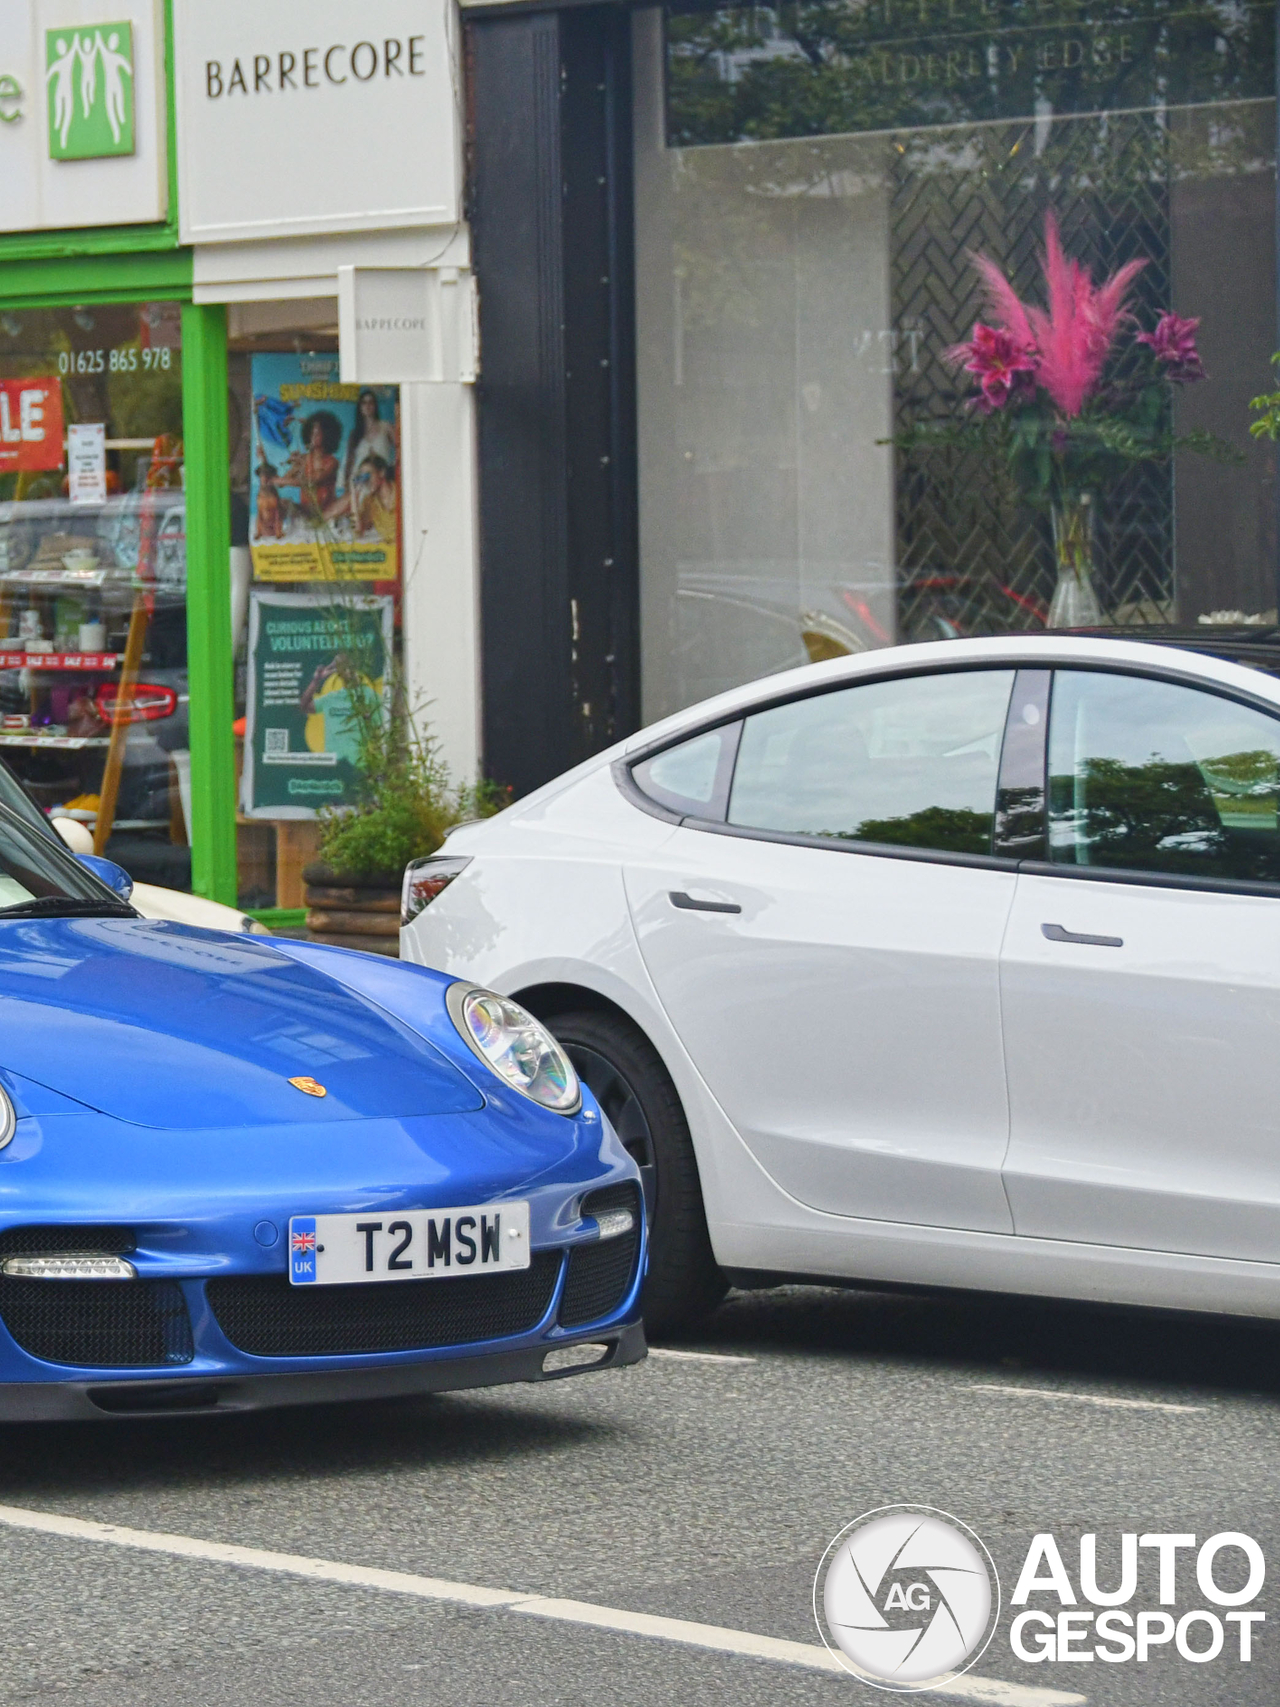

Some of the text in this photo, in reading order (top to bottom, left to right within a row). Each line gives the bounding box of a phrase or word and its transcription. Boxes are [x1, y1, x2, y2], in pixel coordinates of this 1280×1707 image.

[206, 35, 425, 98] BARRECORE
[58, 346, 171, 374] 01625 865 978
[356, 1213, 500, 1272] T2 MSW
[294, 1262, 312, 1273] UK
